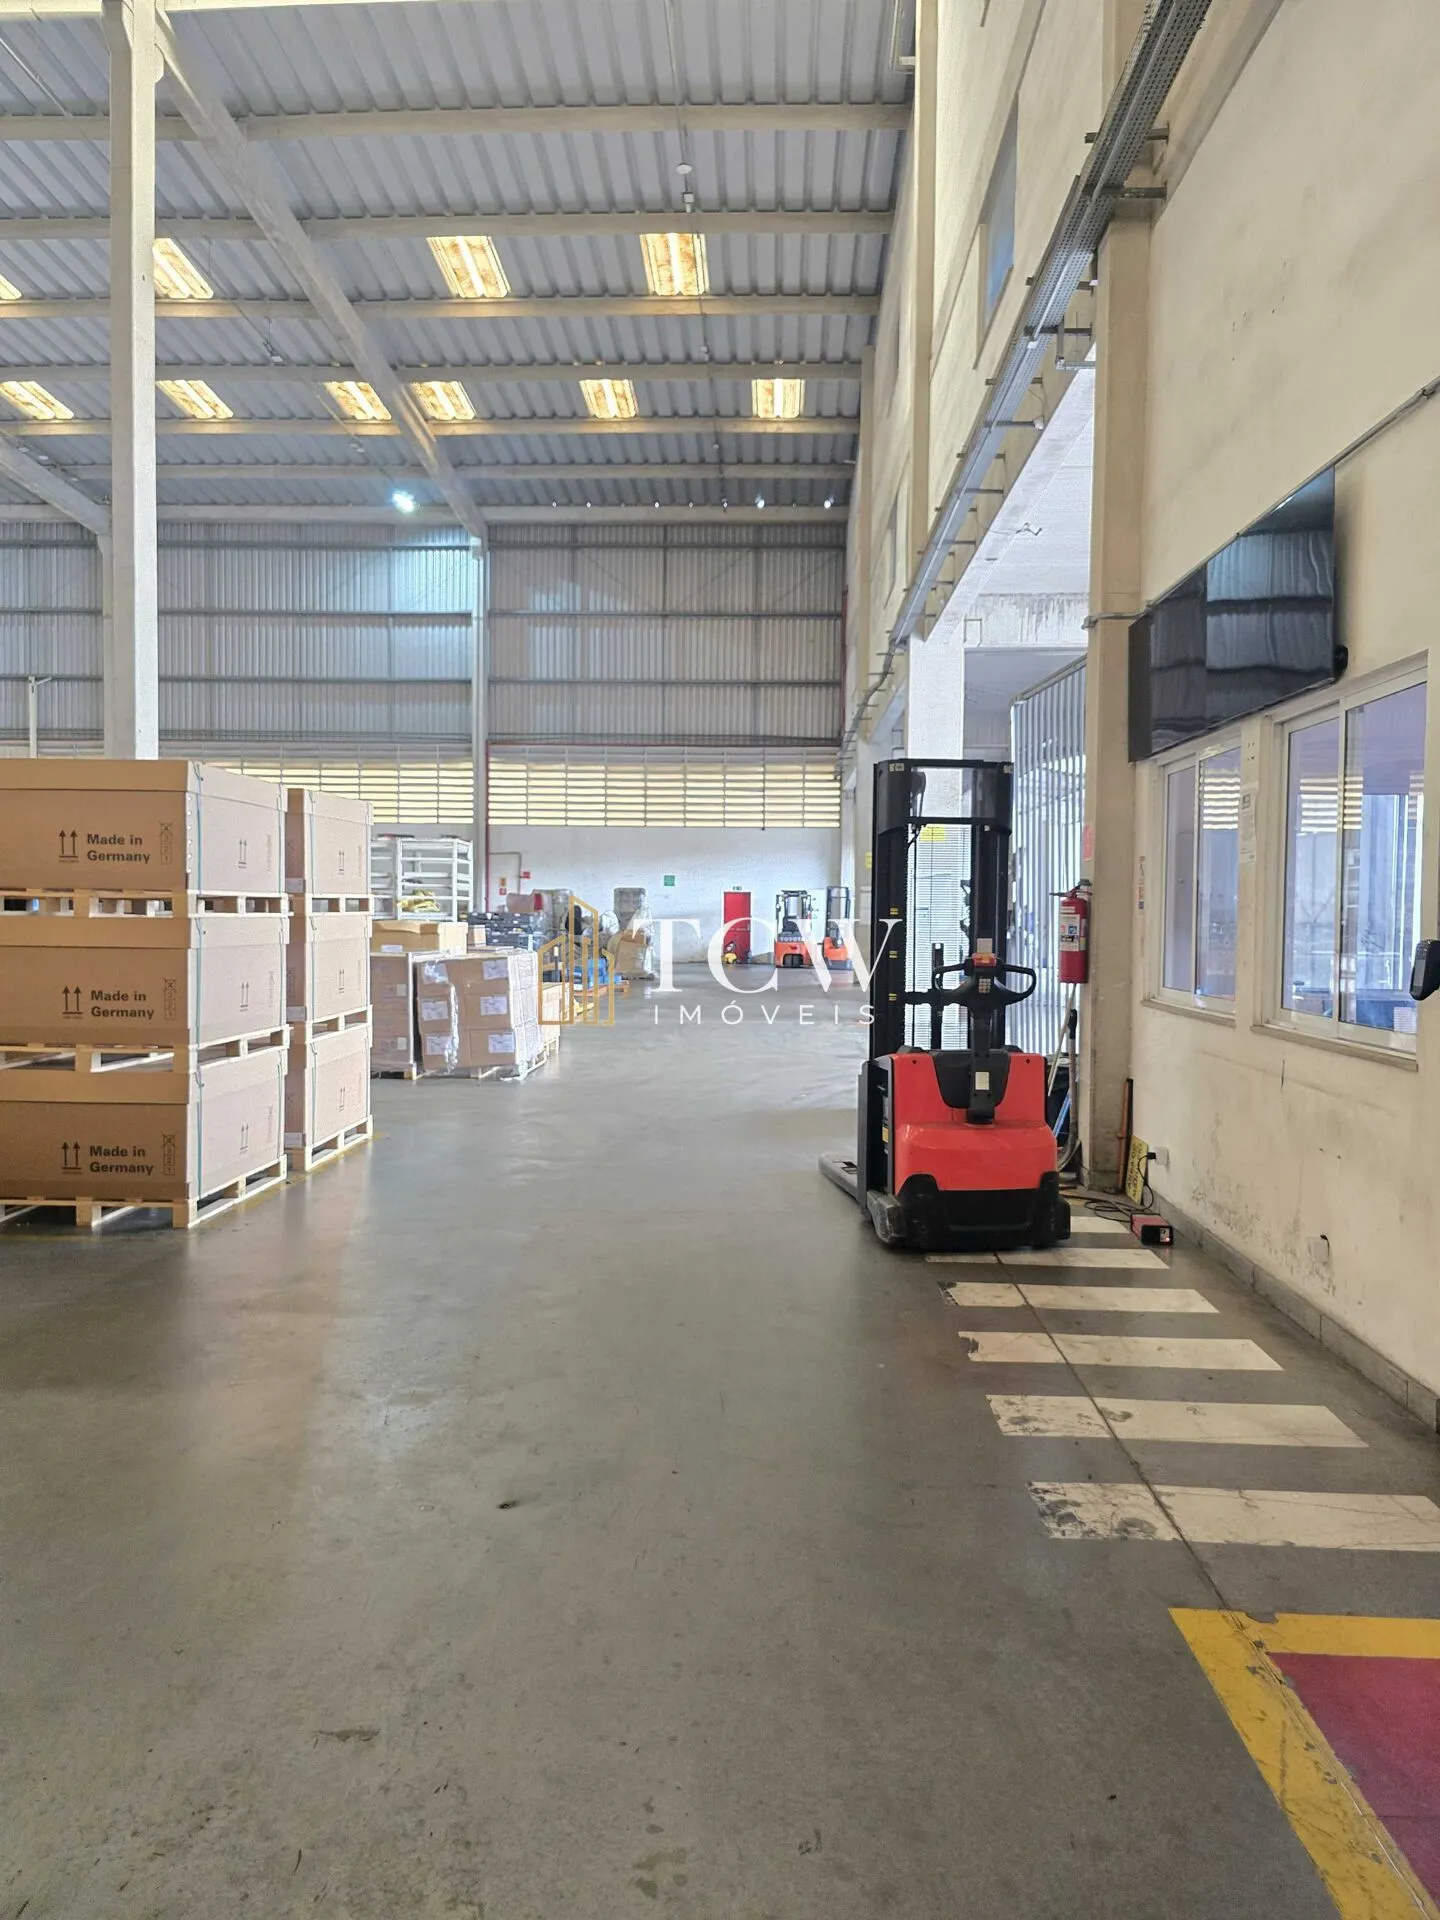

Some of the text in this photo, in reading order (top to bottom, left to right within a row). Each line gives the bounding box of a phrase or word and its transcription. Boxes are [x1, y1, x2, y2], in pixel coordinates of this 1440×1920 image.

[86, 833, 143, 845] Made in
[86, 849, 151, 864] Germany
[90, 989, 147, 1001] Made in
[90, 1005, 154, 1020] Germany
[89, 1145, 146, 1157] Made in
[89, 1161, 154, 1176] Germany
